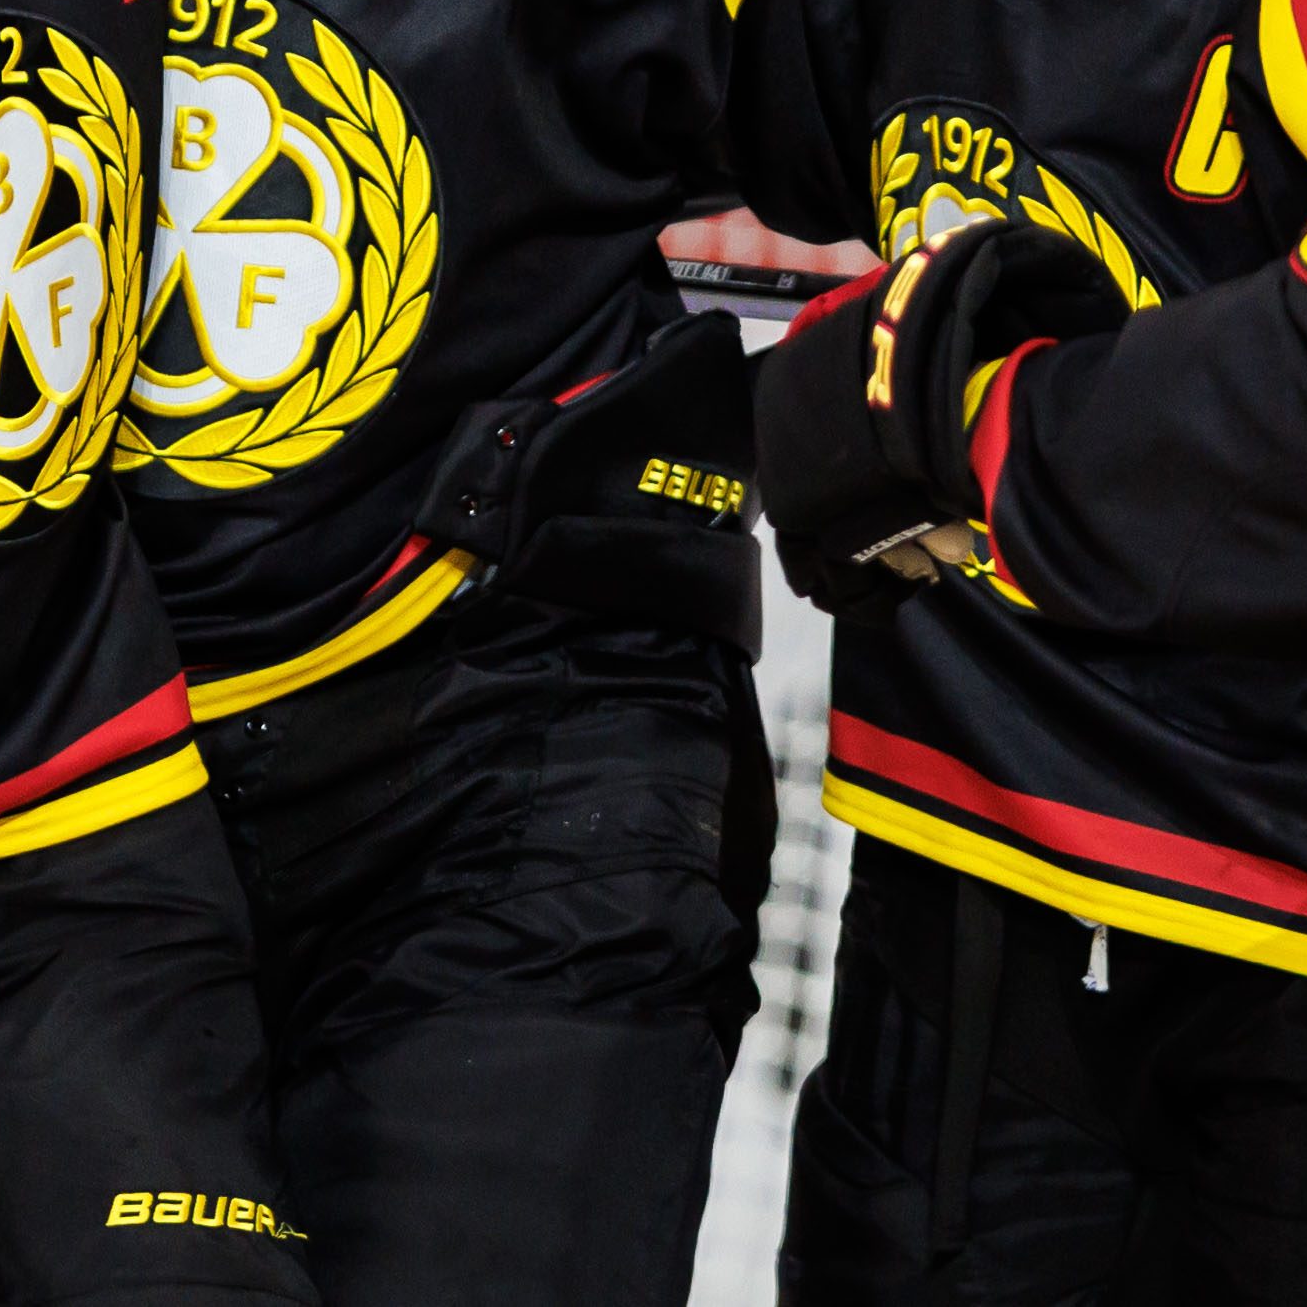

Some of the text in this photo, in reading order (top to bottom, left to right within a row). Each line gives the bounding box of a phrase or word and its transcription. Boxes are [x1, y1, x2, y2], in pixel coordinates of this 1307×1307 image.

[172, 105, 218, 171] B
[922, 114, 1016, 199] 1912
[48, 275, 75, 348] F
[236, 264, 286, 329] F
[637, 457, 745, 515] BAUER
[105, 1191, 278, 1238] BAUER
